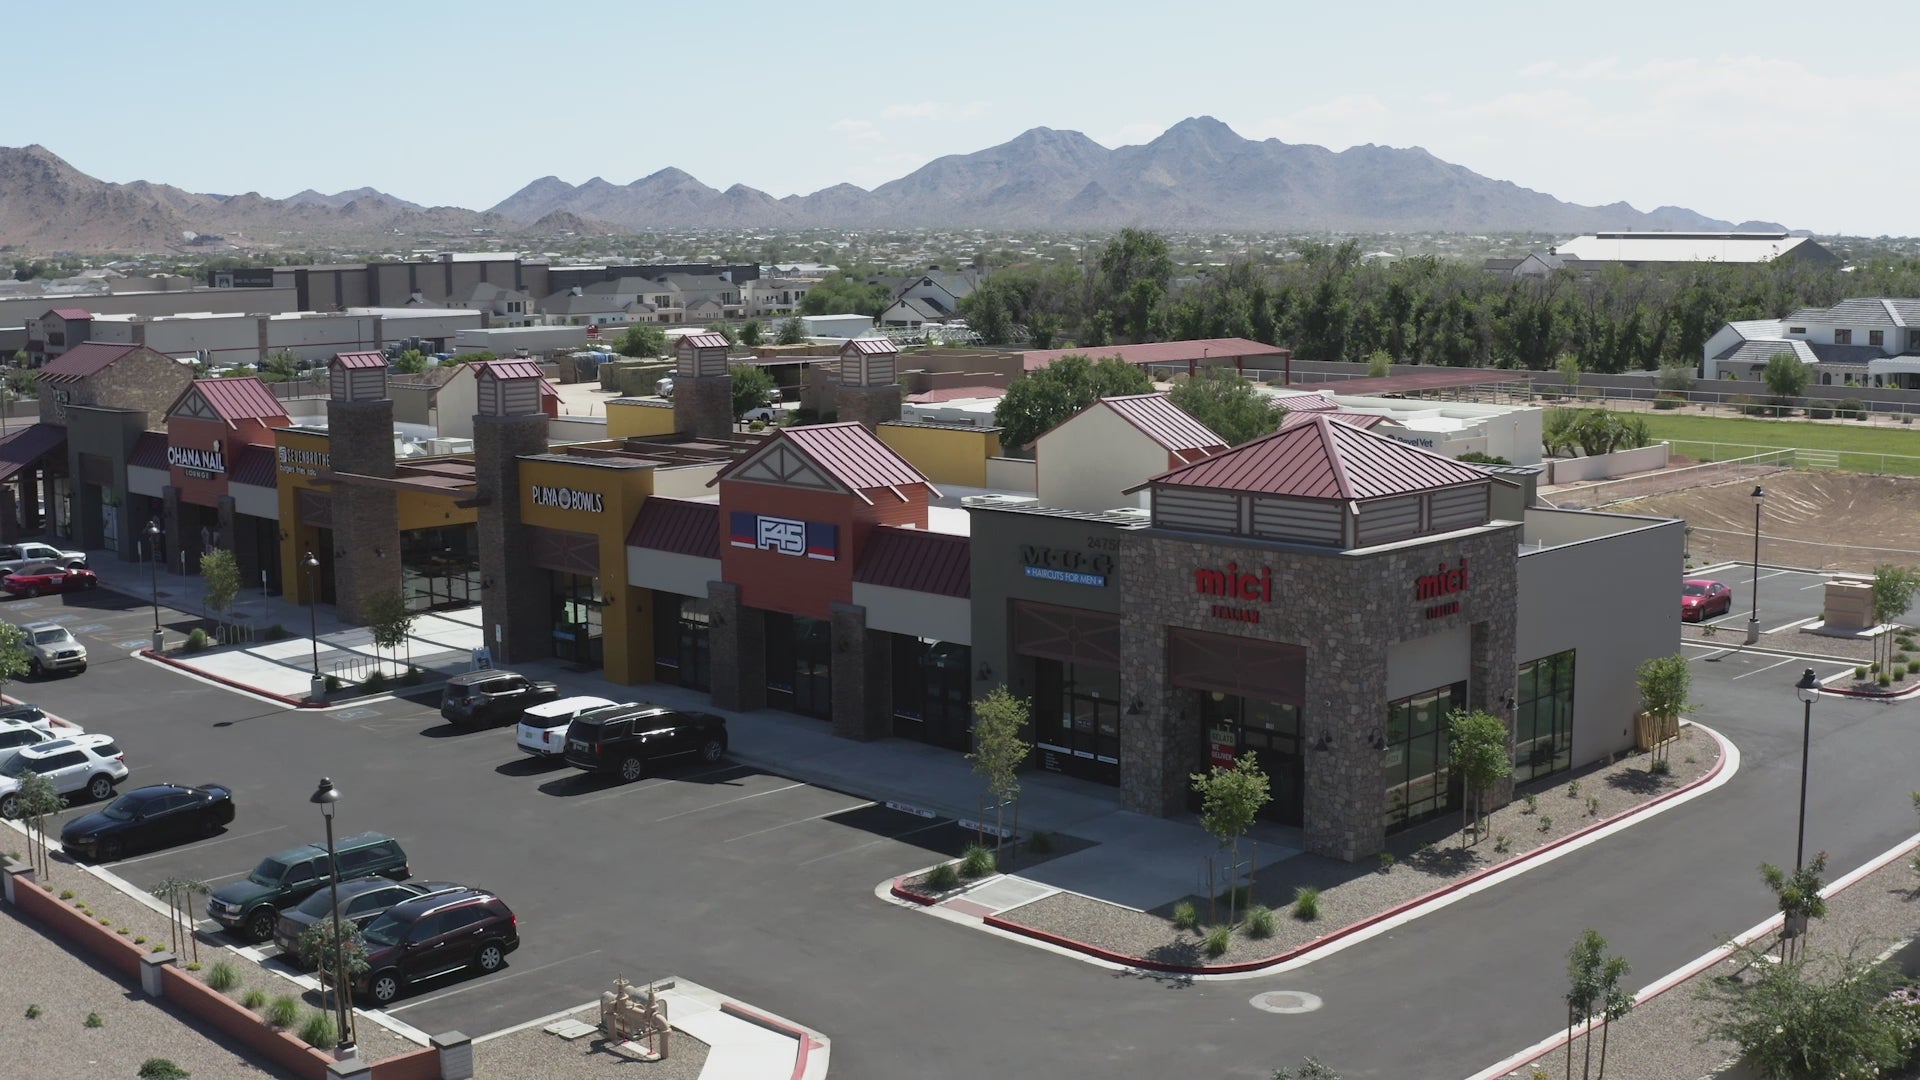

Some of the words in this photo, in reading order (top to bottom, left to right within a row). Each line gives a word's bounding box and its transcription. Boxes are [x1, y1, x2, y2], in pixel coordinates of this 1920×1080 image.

[1420, 438, 1433, 447] Vet
[168, 446, 201, 467] OHANA
[202, 451, 225, 471] NAIL
[185, 469, 209, 479] LOUNGE
[532, 485, 559, 507] PLAYA
[572, 490, 603, 513] BOWLS
[758, 515, 805, 556] F45
[1032, 568, 1064, 581] HAIRCUTS
[1065, 571, 1079, 582] FOR
[1080, 575, 1097, 585] MEN
[1194, 562, 1271, 602] mici
[1416, 558, 1469, 601] mici
[1209, 605, 1259, 624] ITALIAN
[1211, 732, 1234, 744] GELATO
